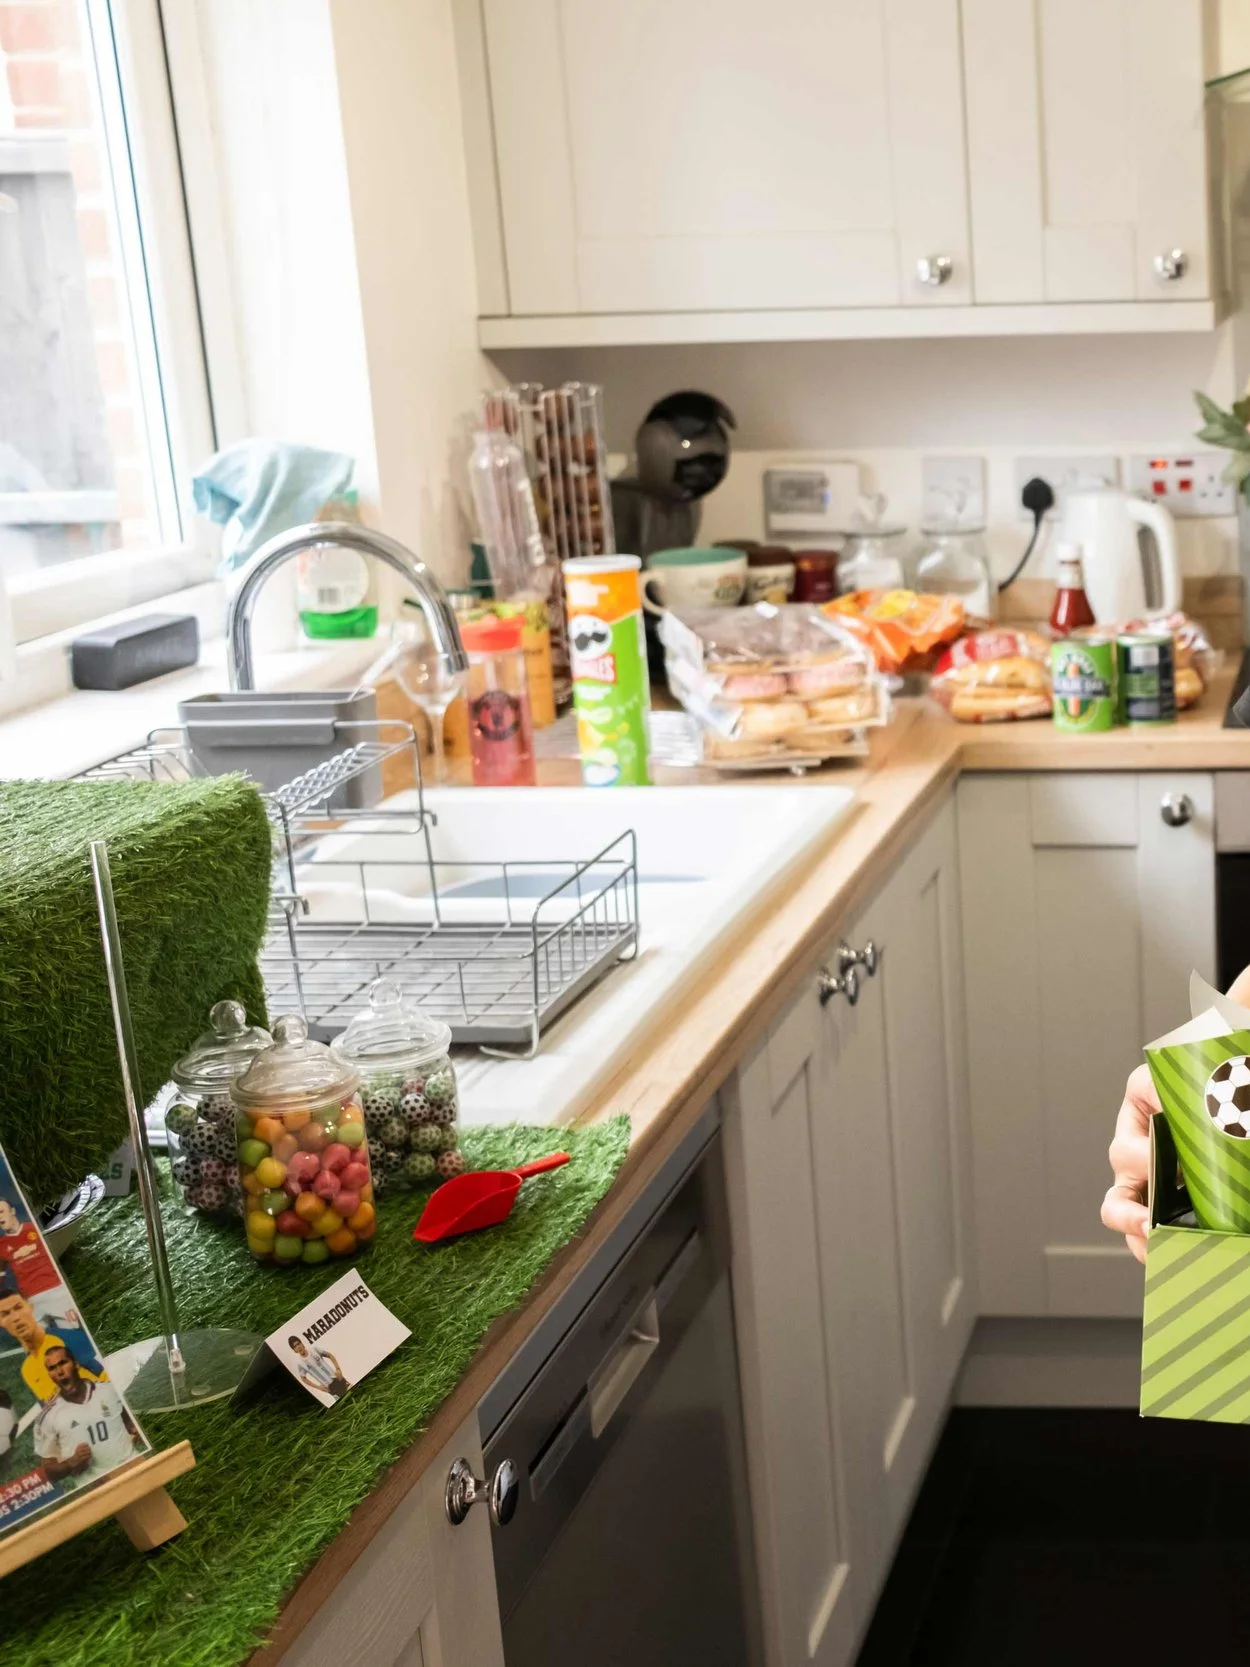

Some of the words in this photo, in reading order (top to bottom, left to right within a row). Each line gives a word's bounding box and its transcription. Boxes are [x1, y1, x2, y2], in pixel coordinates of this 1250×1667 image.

[302, 1285, 370, 1345] MARADONUTS
[87, 1421, 109, 1445] 10
[22, 1472, 42, 1490] PM
[10, 1480, 55, 1510] 2:30PM
